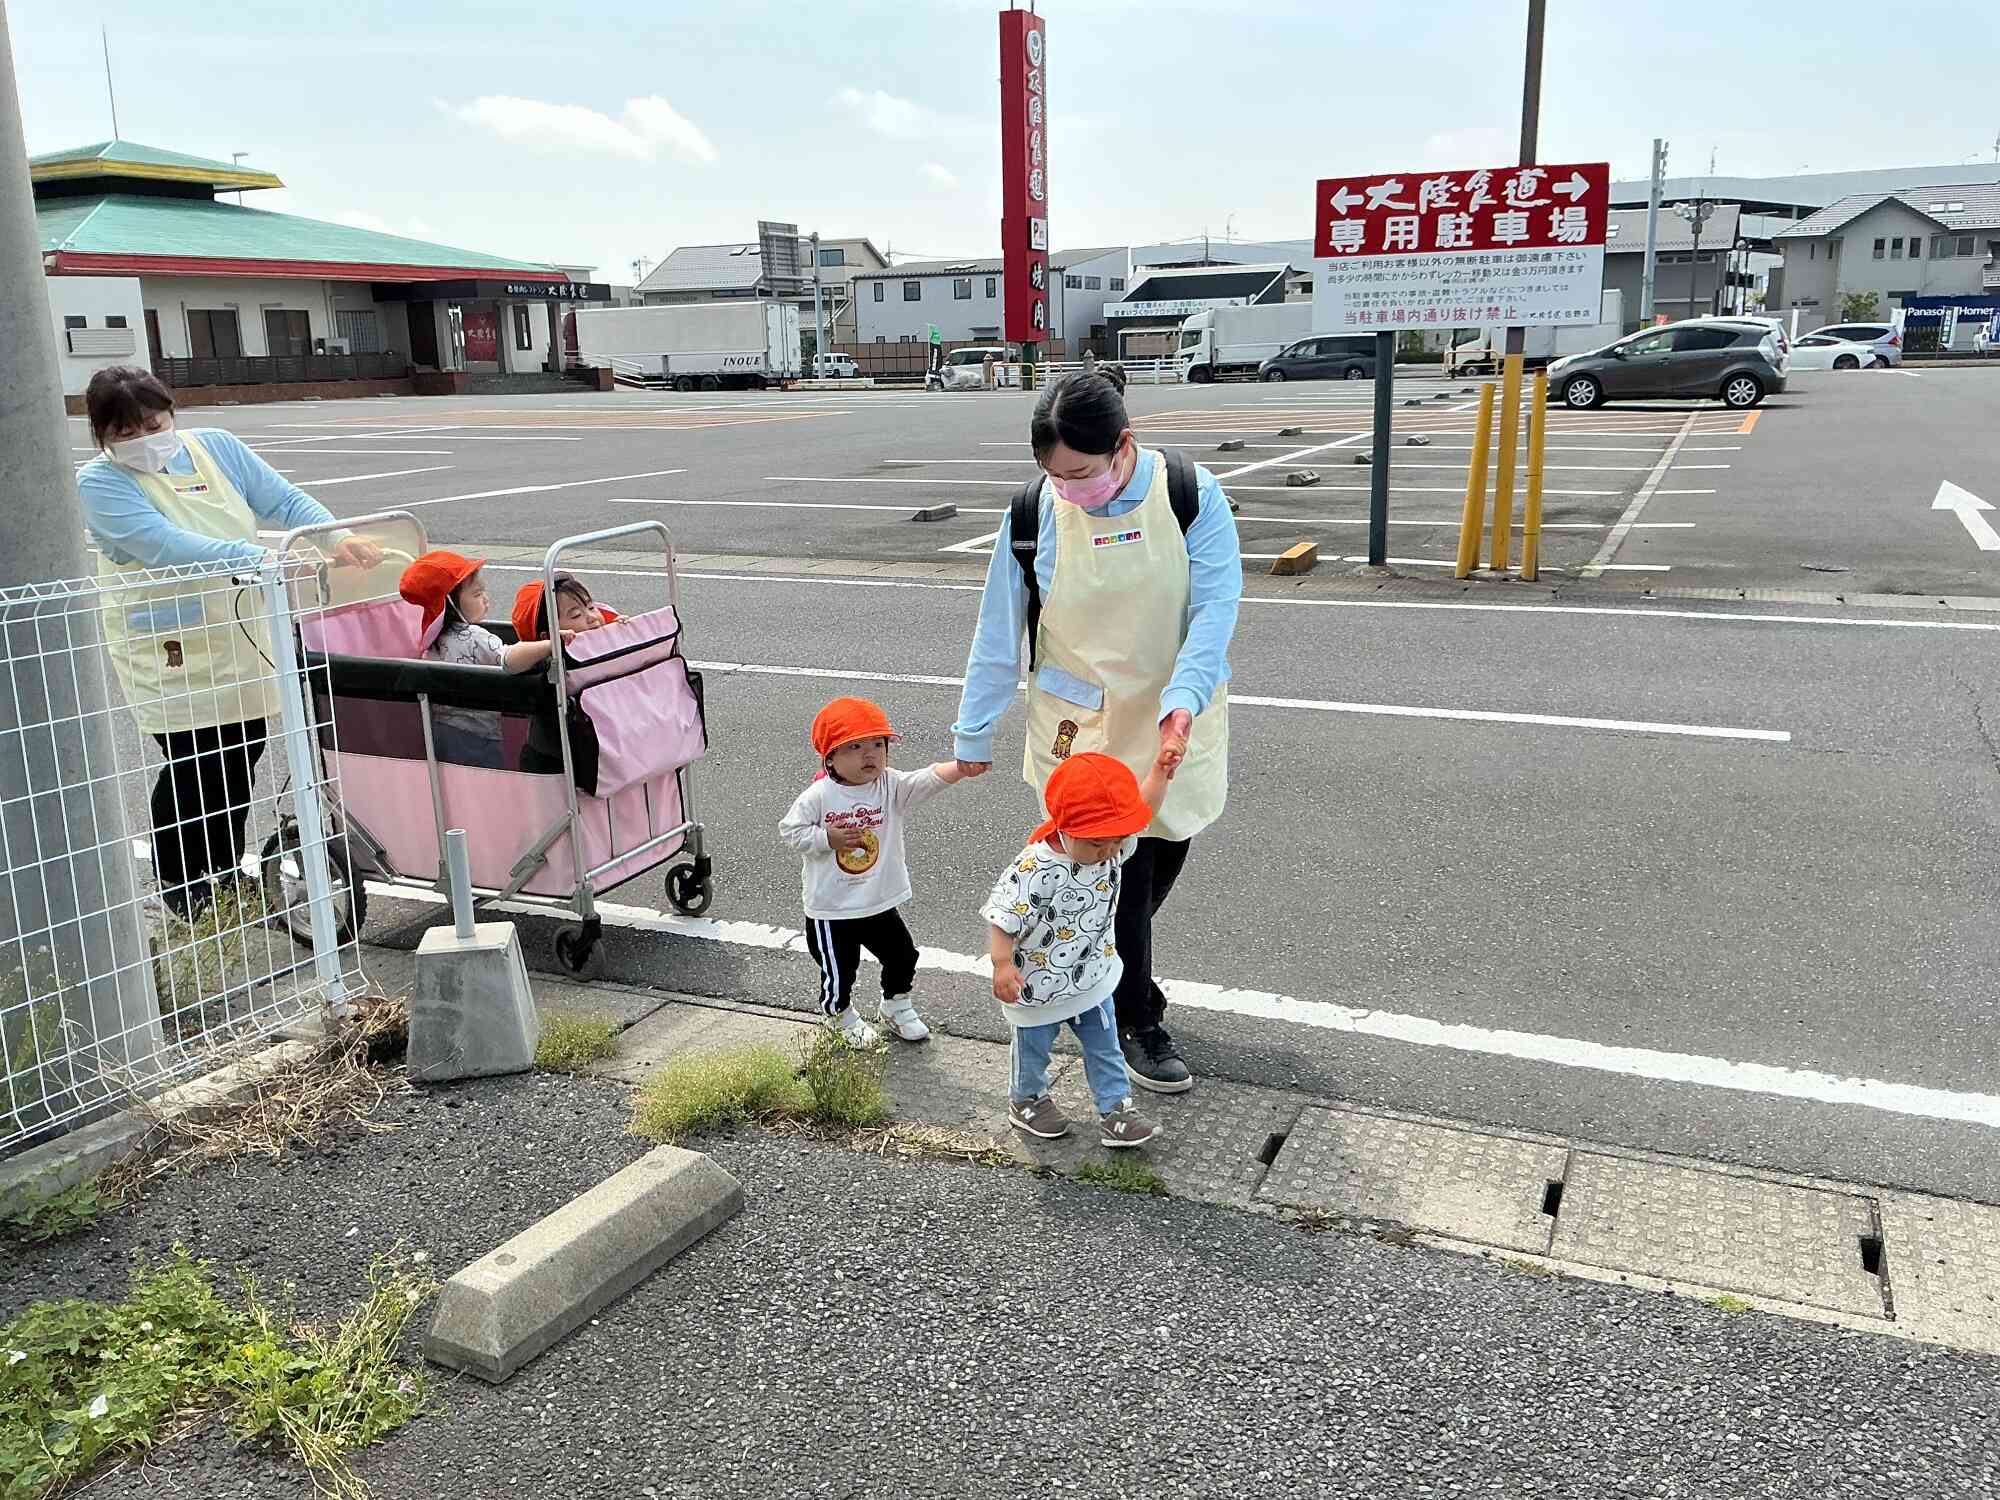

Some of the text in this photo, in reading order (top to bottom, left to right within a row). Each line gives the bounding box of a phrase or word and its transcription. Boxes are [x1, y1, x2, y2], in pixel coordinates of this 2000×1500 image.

[1365, 168, 1551, 214] 大陸食道
[1329, 206, 1588, 253] 専用駐車場
[1032, 261, 1045, 331] 焼肉
[1344, 305, 1517, 324] 当駐車場内通り抜け禁止
[723, 356, 761, 367] INOUE
